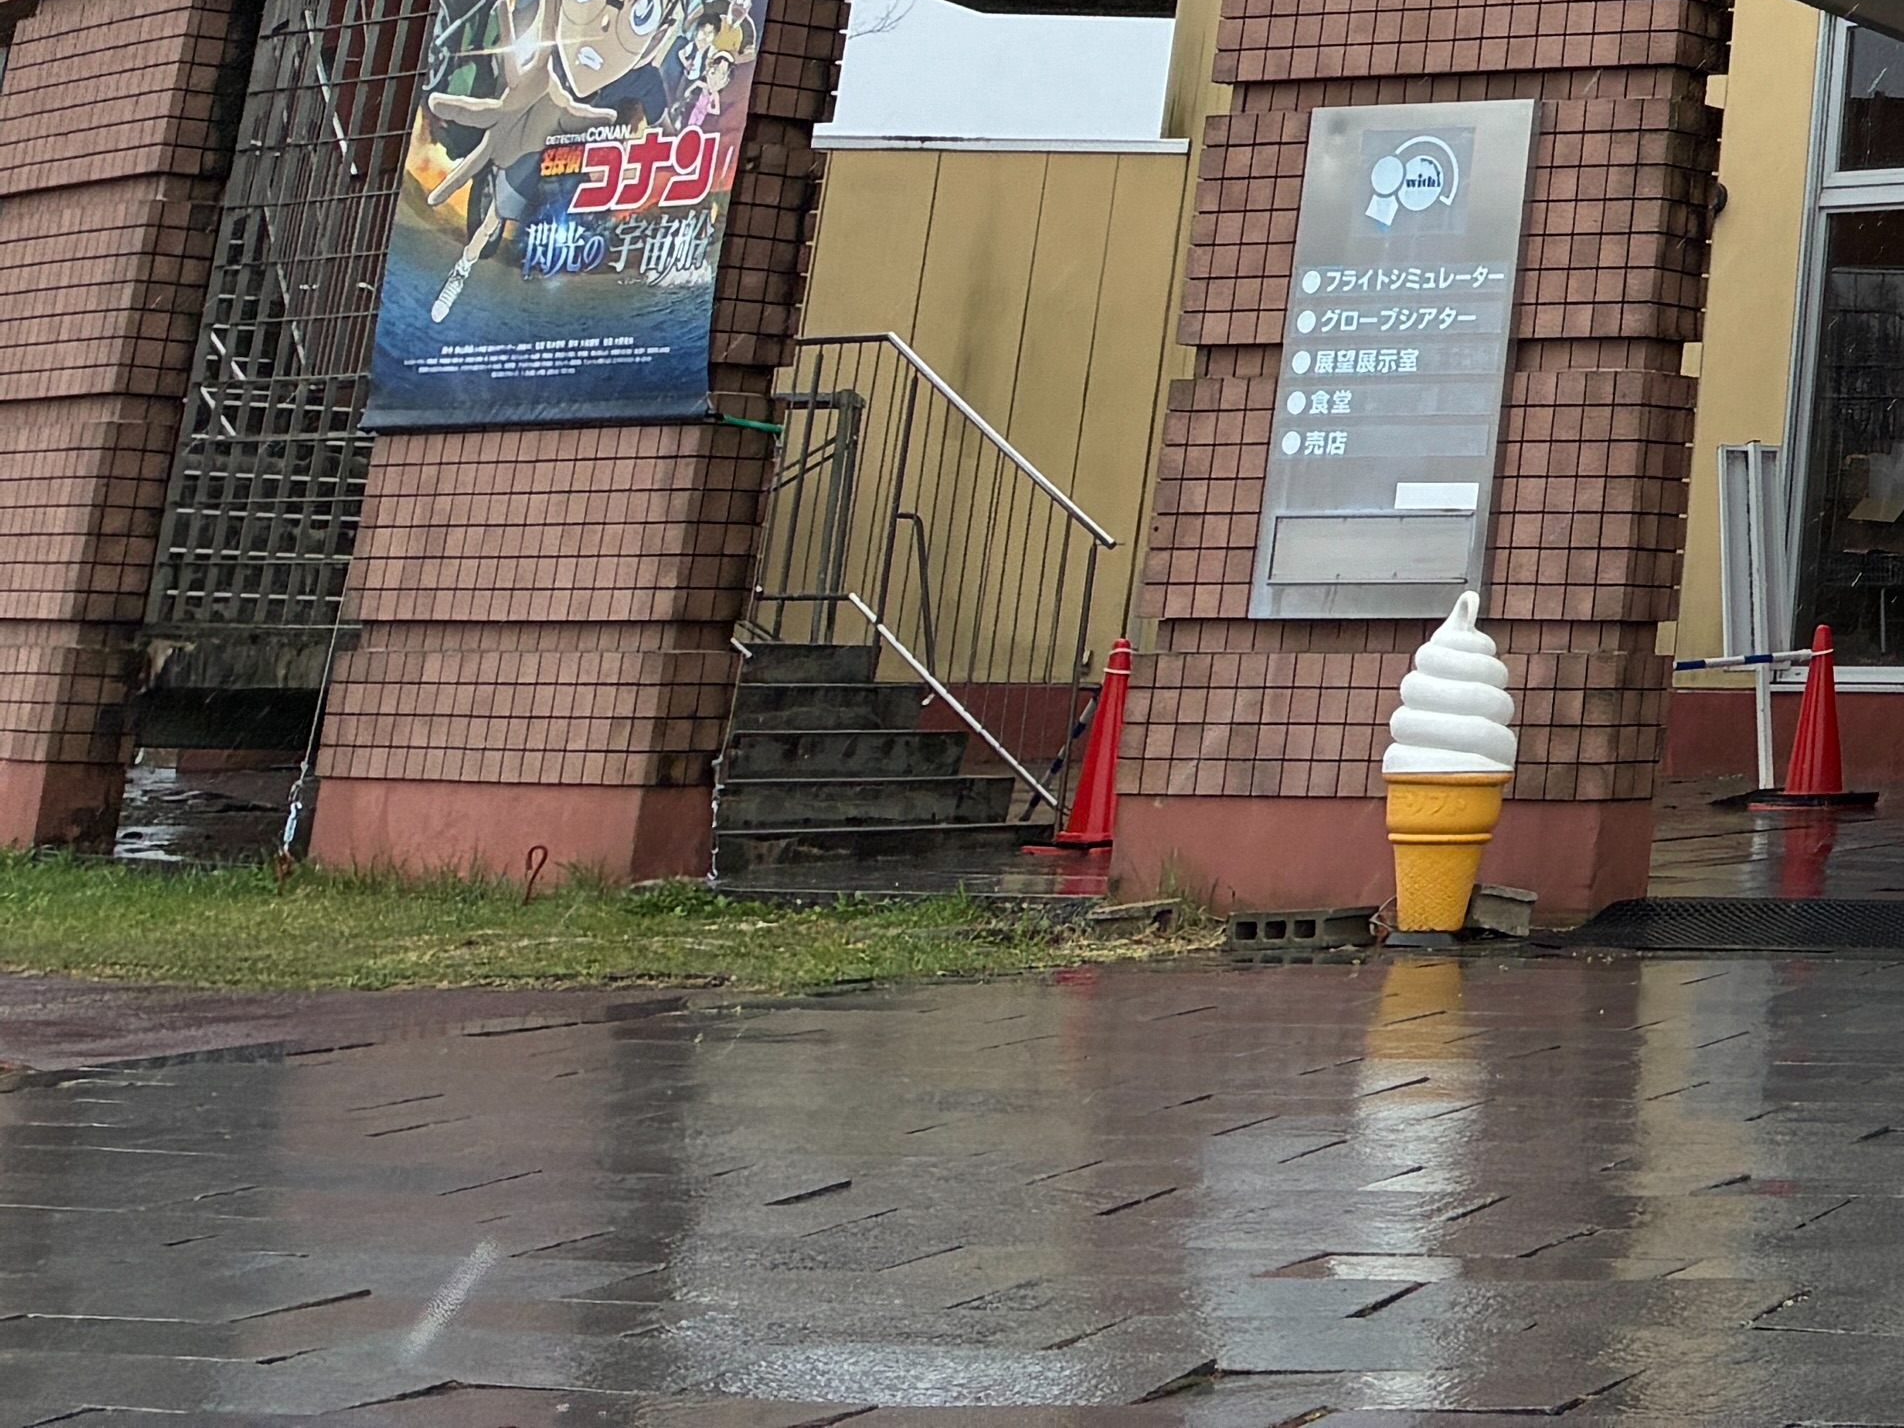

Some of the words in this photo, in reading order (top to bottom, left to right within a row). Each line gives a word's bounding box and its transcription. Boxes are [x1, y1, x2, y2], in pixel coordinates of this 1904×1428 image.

[567, 125, 721, 214] コナン
[1325, 268, 1505, 292] フライトシミュレーター
[1320, 309, 1477, 334] グローブシアター
[1314, 347, 1420, 375] 展望展示室
[1308, 389, 1352, 416] 食堂
[1303, 430, 1348, 456] 売店
